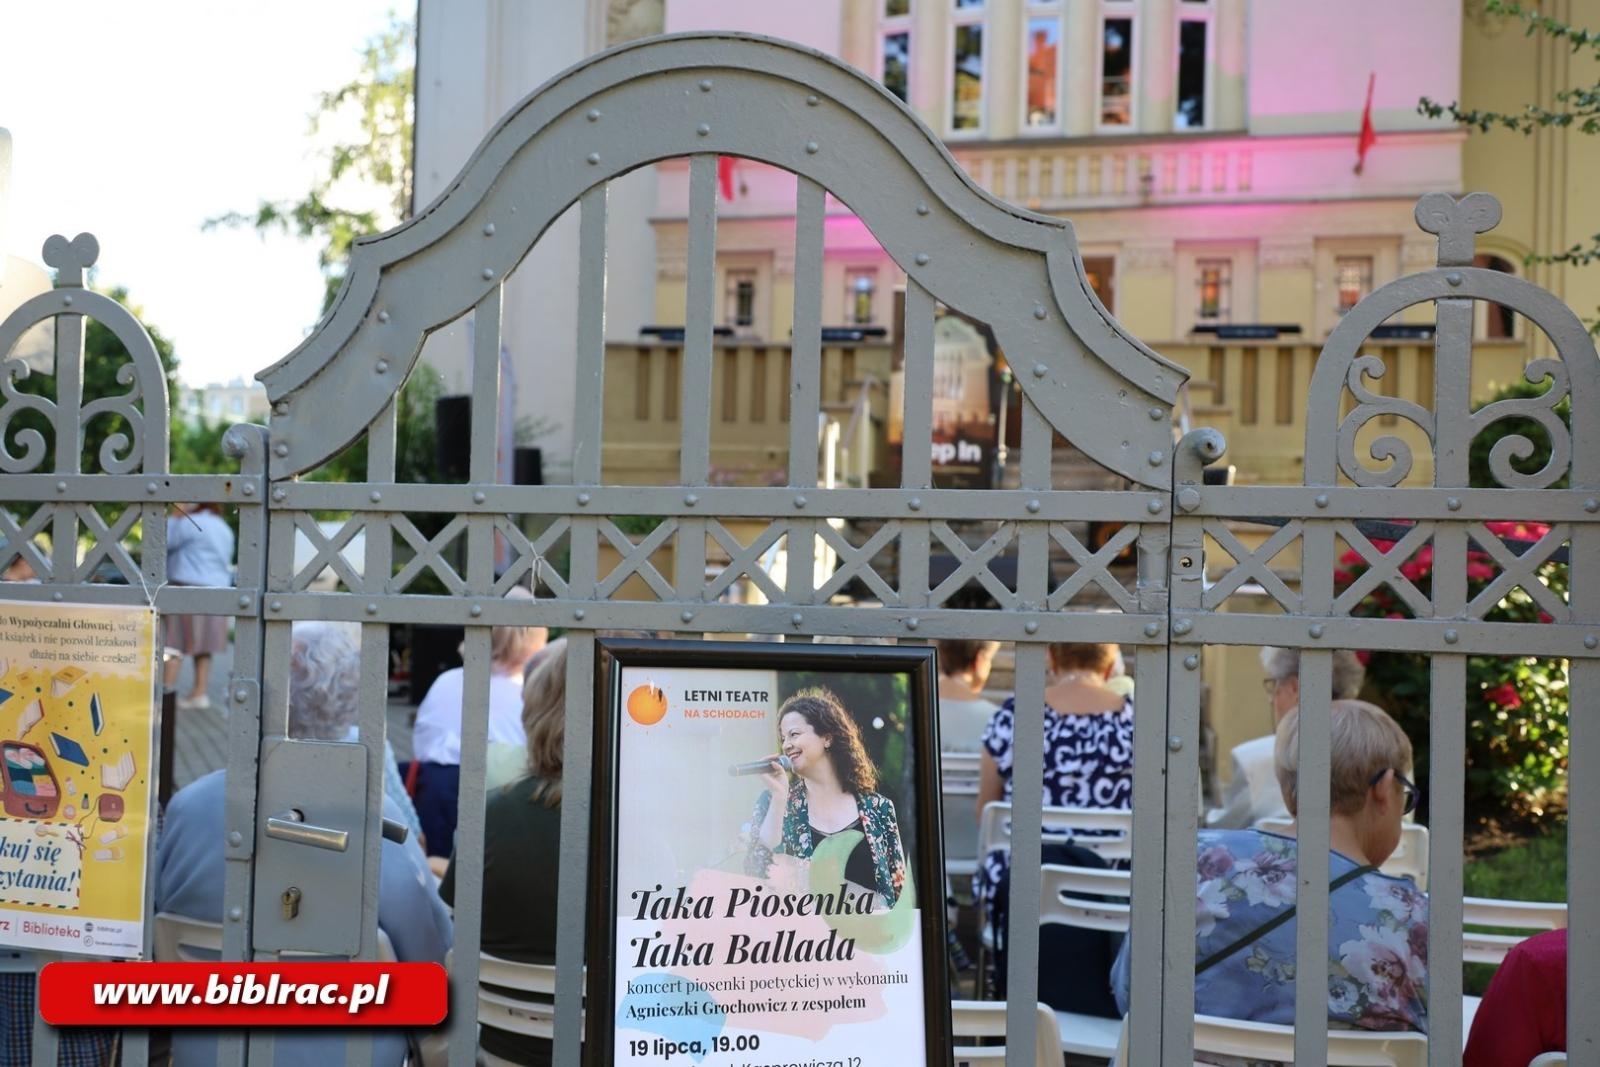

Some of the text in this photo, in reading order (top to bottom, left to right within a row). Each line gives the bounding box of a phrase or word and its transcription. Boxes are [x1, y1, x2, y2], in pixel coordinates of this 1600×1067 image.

[9, 616, 71, 630] Wypożyczalni
[5, 632, 36, 645] książek
[44, 634, 58, 645] nie
[60, 636, 94, 648] pozwól
[95, 636, 137, 648] leżakowi
[30, 649, 137, 665] dłużej na siebie czekać!
[684, 690, 769, 702] LETNI TEATR
[684, 709, 766, 719] NA SCHODACH
[33, 841, 62, 866] się
[630, 884, 875, 921] Taka Piosenka
[23, 921, 81, 939] Biblioteka
[629, 929, 856, 968] Taka Ballada
[627, 970, 909, 995] koncert piosenki poetyckiej w wykonaniu
[626, 995, 866, 1020] Agnieszki Grochowicz z zespołem
[629, 1034, 760, 1061] 19 lipca, 19.00
